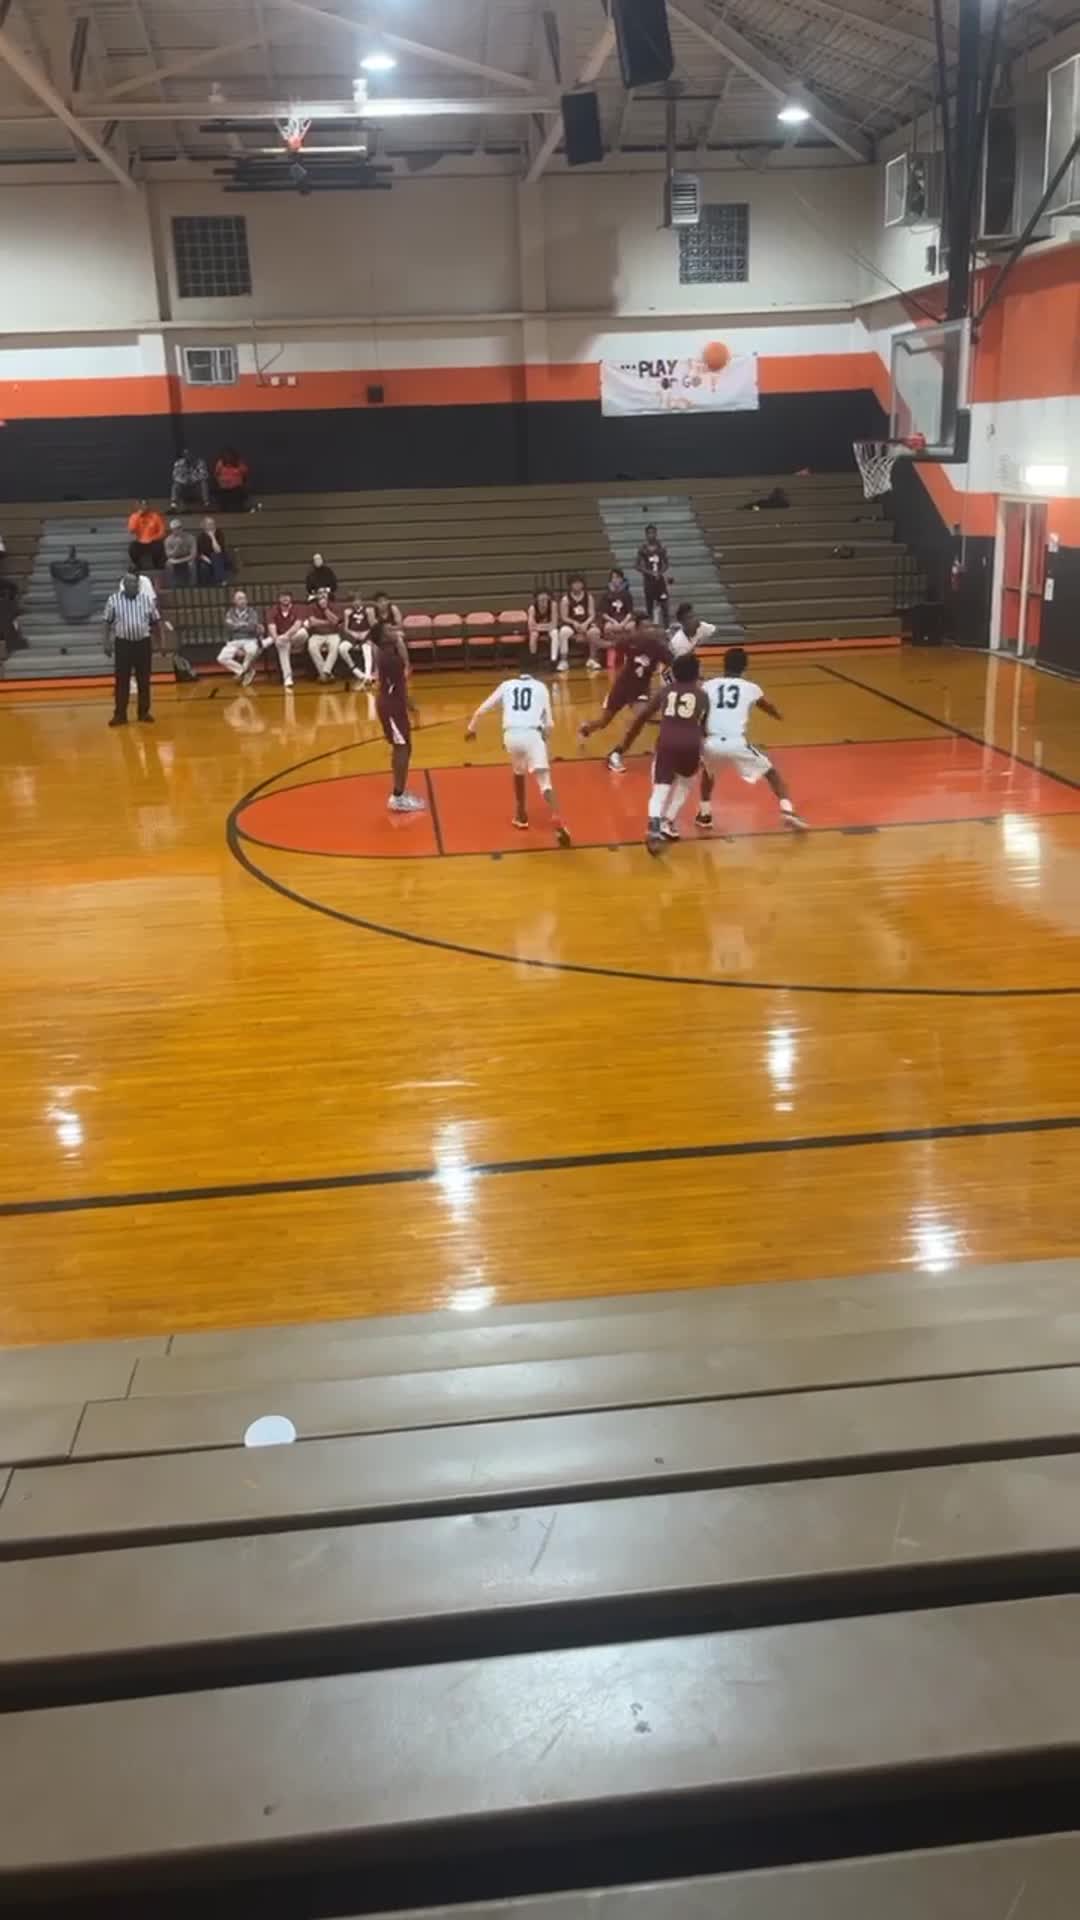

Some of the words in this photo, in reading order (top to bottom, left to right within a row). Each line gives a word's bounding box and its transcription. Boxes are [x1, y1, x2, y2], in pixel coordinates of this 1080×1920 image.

[512, 687, 532, 711] 10
[664, 691, 696, 719] 13
[716, 684, 740, 709] 13
